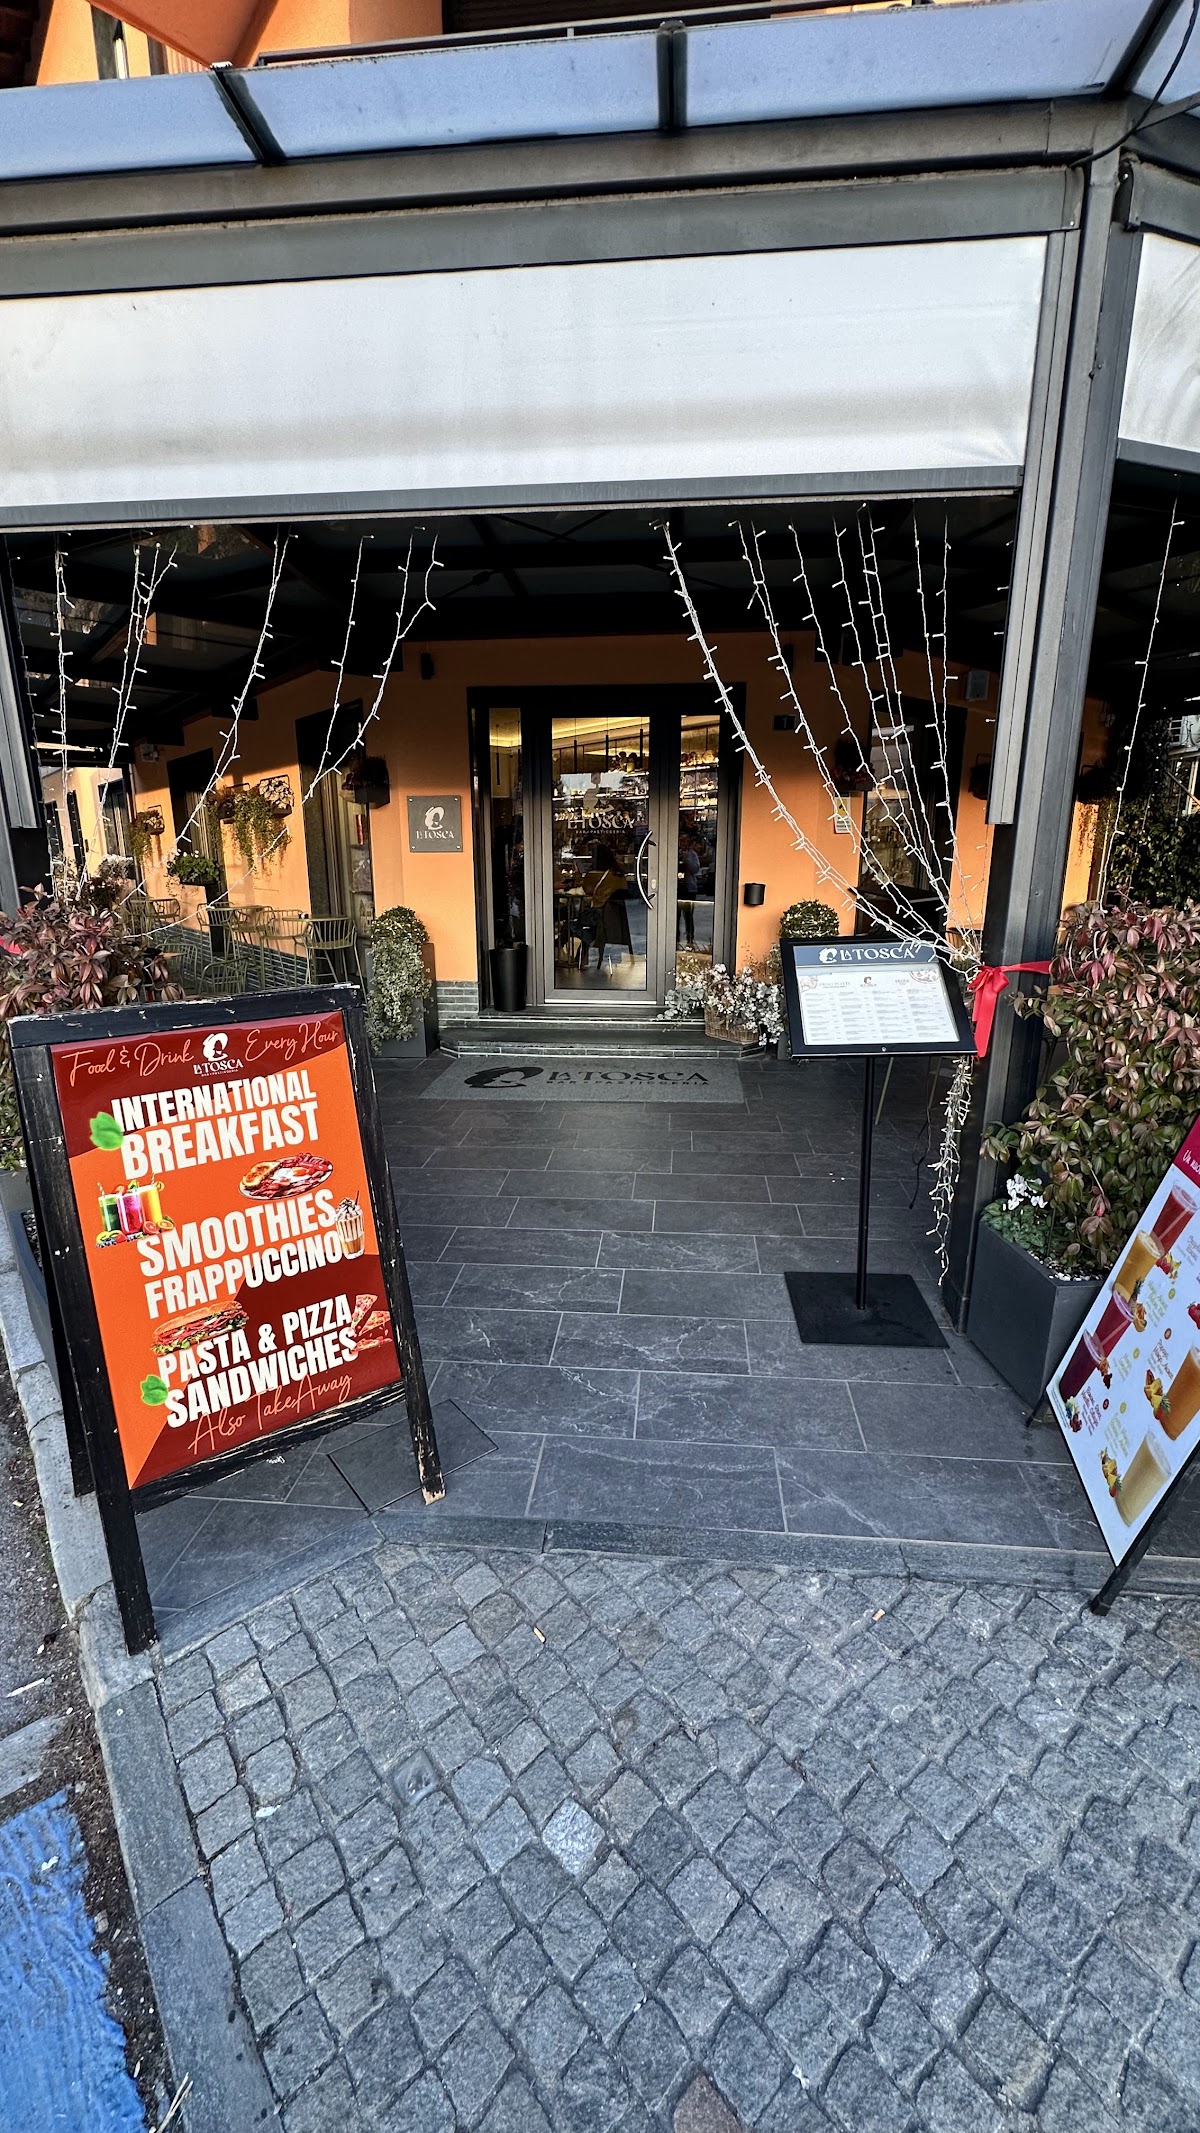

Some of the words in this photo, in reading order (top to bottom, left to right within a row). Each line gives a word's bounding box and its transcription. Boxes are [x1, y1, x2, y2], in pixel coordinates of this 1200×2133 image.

[424, 830, 455, 839] TOSCA
[852, 948, 916, 960] TOSCA
[62, 1050, 116, 1087] Food
[119, 1045, 131, 1068] &
[134, 1038, 195, 1077] Drink
[245, 1028, 300, 1062] Every
[299, 1019, 340, 1054] Hour
[202, 1058, 244, 1074] TOSCA
[578, 1071, 709, 1082] TOSCA
[111, 1069, 317, 1134] INTERNATIONAL
[121, 1101, 321, 1181] BREAKFAST
[136, 1188, 337, 1277] SMOOTHIES
[144, 1229, 344, 1320] FRAPPUCCINO
[157, 1328, 251, 1388] PASTA
[257, 1323, 276, 1354] &
[281, 1293, 352, 1345] PIZZA
[164, 1326, 359, 1429] SANDWICHES
[187, 1406, 246, 1456] Also
